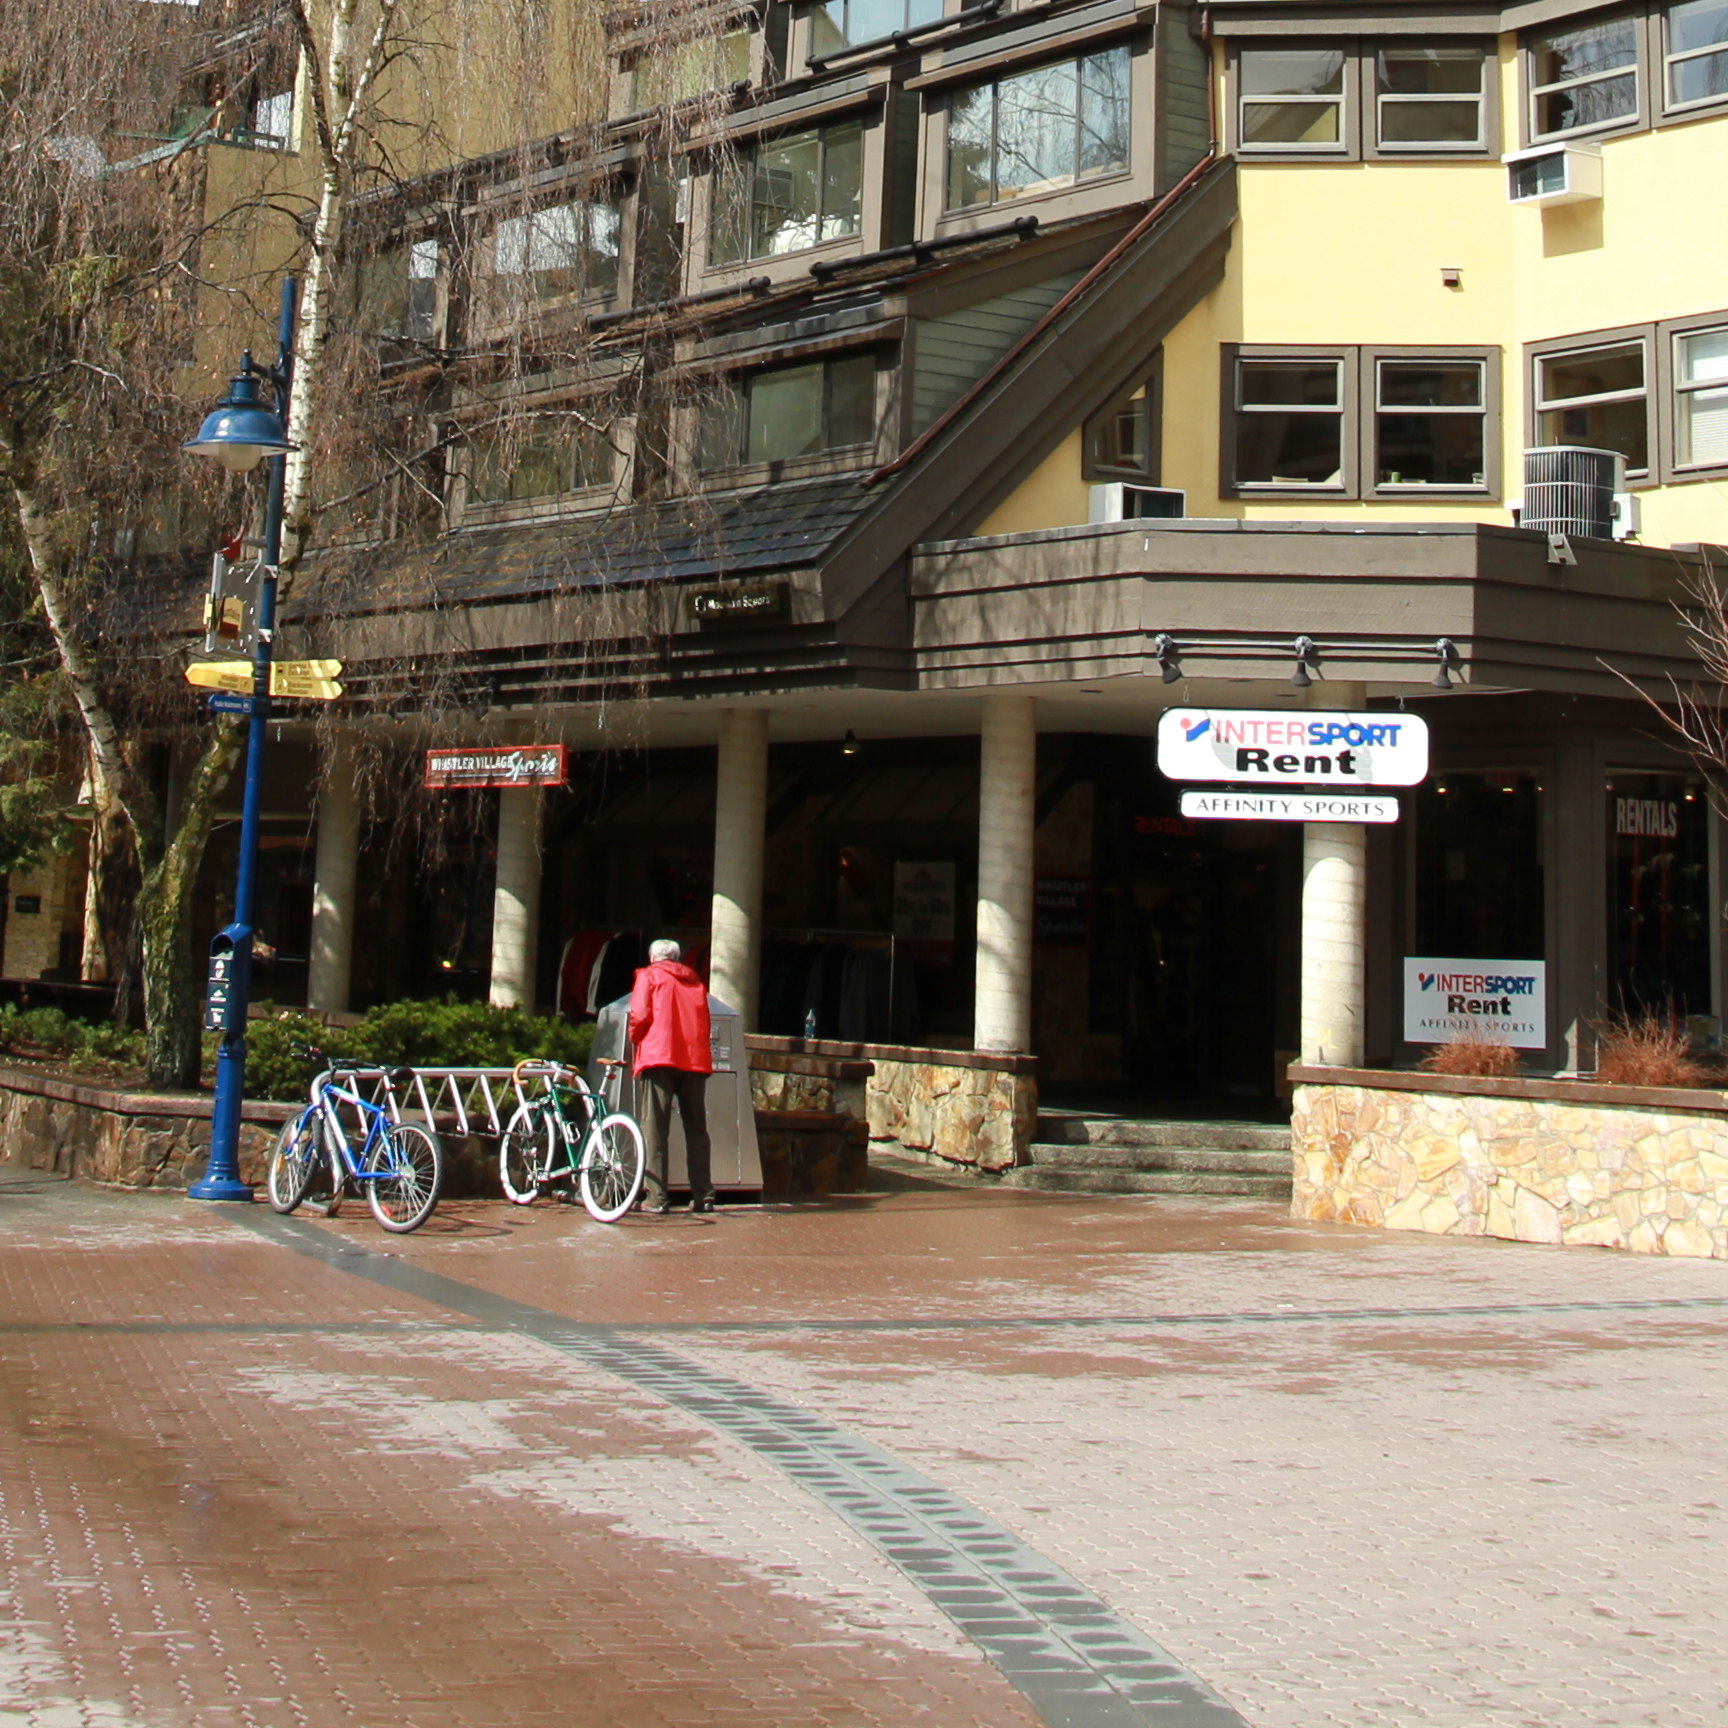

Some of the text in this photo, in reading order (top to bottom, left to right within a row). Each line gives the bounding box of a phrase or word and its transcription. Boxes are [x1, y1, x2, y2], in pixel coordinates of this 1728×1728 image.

[1216, 719, 1402, 747] INTERSPORT
[431, 757, 474, 770] WHISTLER
[475, 755, 513, 770] VILLAGE
[1236, 747, 1357, 774] Rent
[1196, 798, 1385, 817] AFFINITY SPORTS
[1617, 798, 1677, 838] RENTALS
[1437, 973, 1535, 995] INTERSPORT
[1447, 994, 1511, 1016] Rent
[1419, 1018, 1535, 1032] AFFINITY SPORTS
